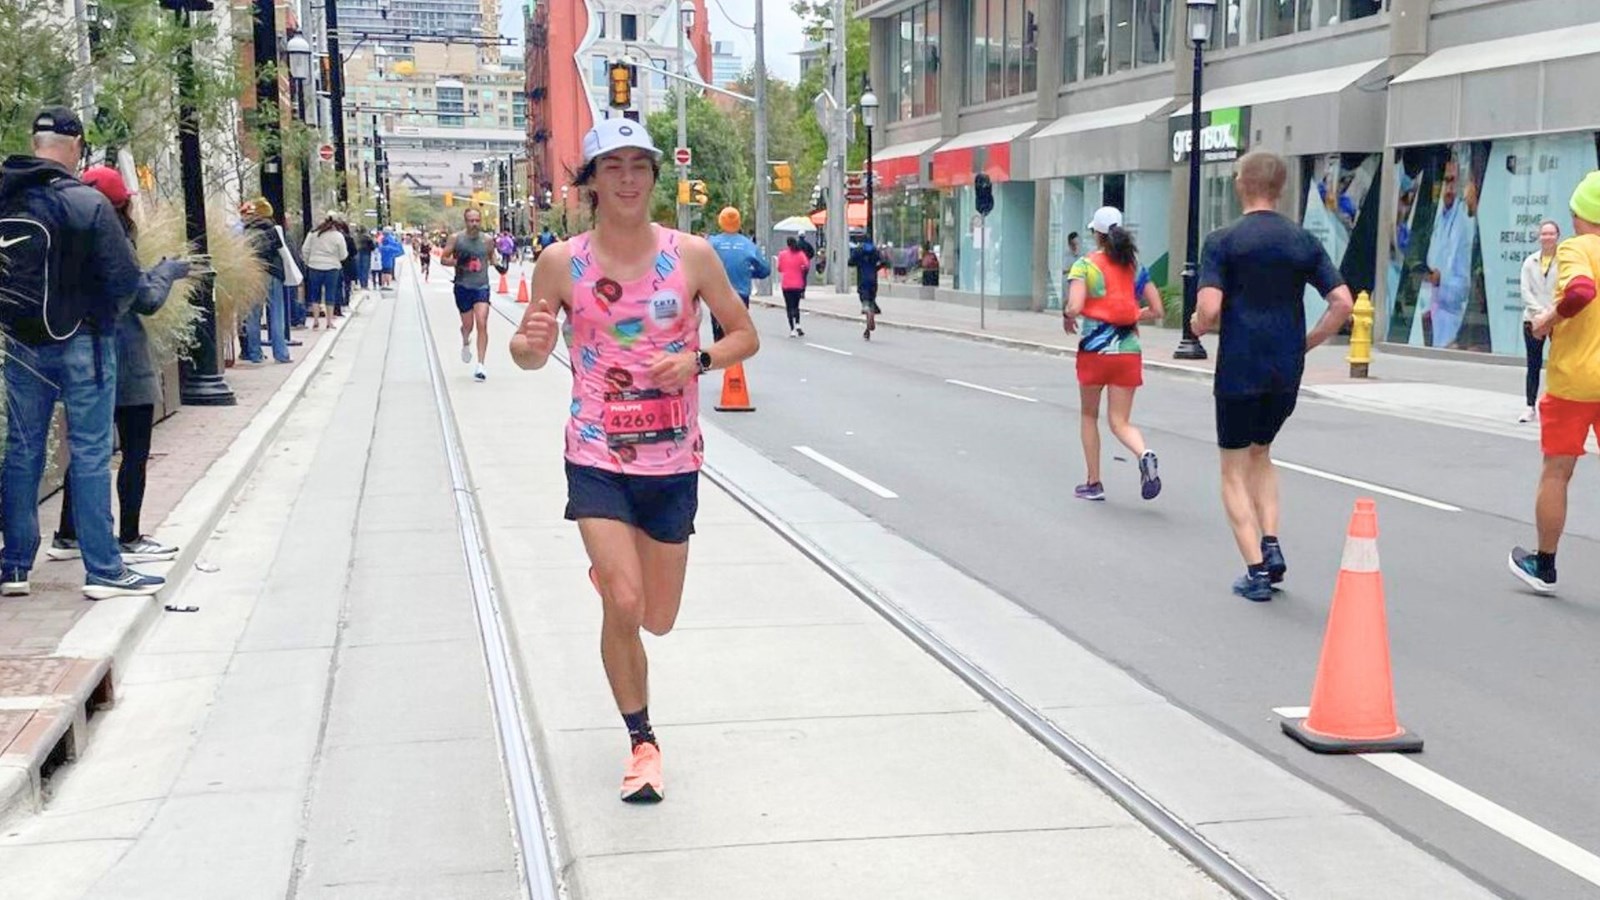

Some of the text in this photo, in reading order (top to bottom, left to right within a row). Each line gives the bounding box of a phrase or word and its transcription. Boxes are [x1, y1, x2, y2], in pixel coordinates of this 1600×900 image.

[1173, 124, 1236, 162] grenBOX
[1500, 231, 1527, 244] RETAIL
[610, 404, 642, 412] PHILIPPE
[611, 413, 655, 428] 4269
